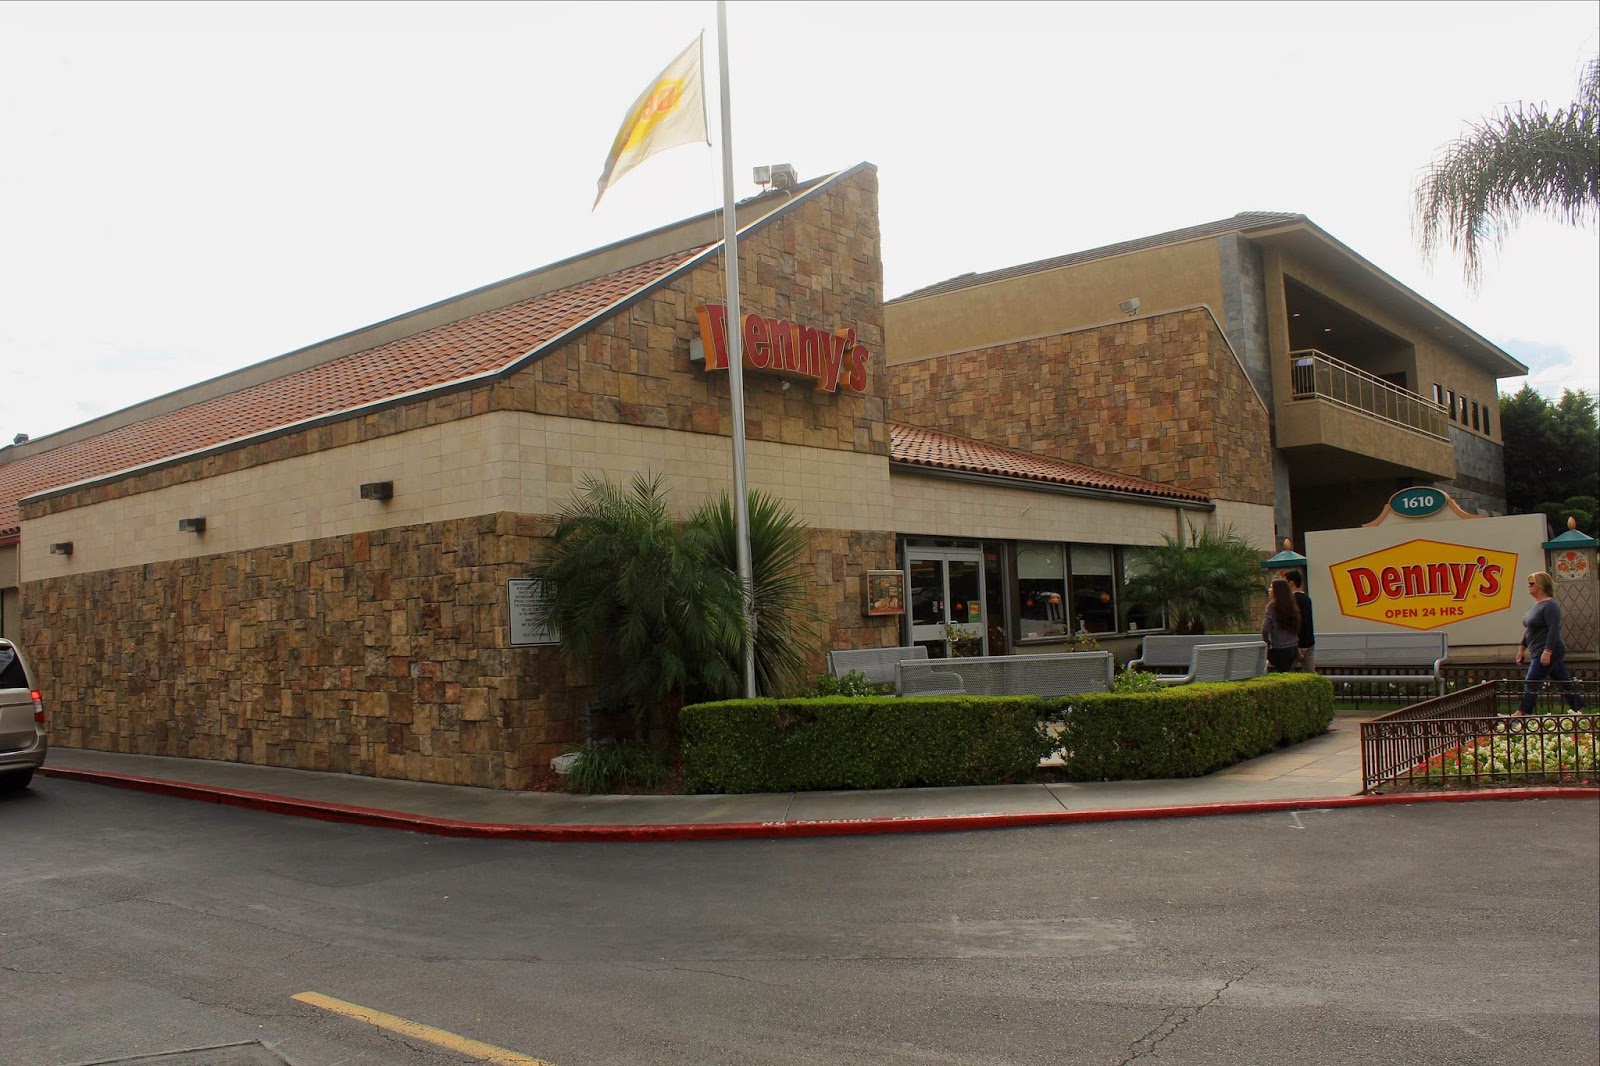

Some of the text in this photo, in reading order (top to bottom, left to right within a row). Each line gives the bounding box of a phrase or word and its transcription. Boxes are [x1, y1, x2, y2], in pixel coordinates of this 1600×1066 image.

[1402, 496, 1434, 509] 1610
[1346, 555, 1503, 607] Denny's
[1384, 606, 1465, 619] OPEN 24 HRS
